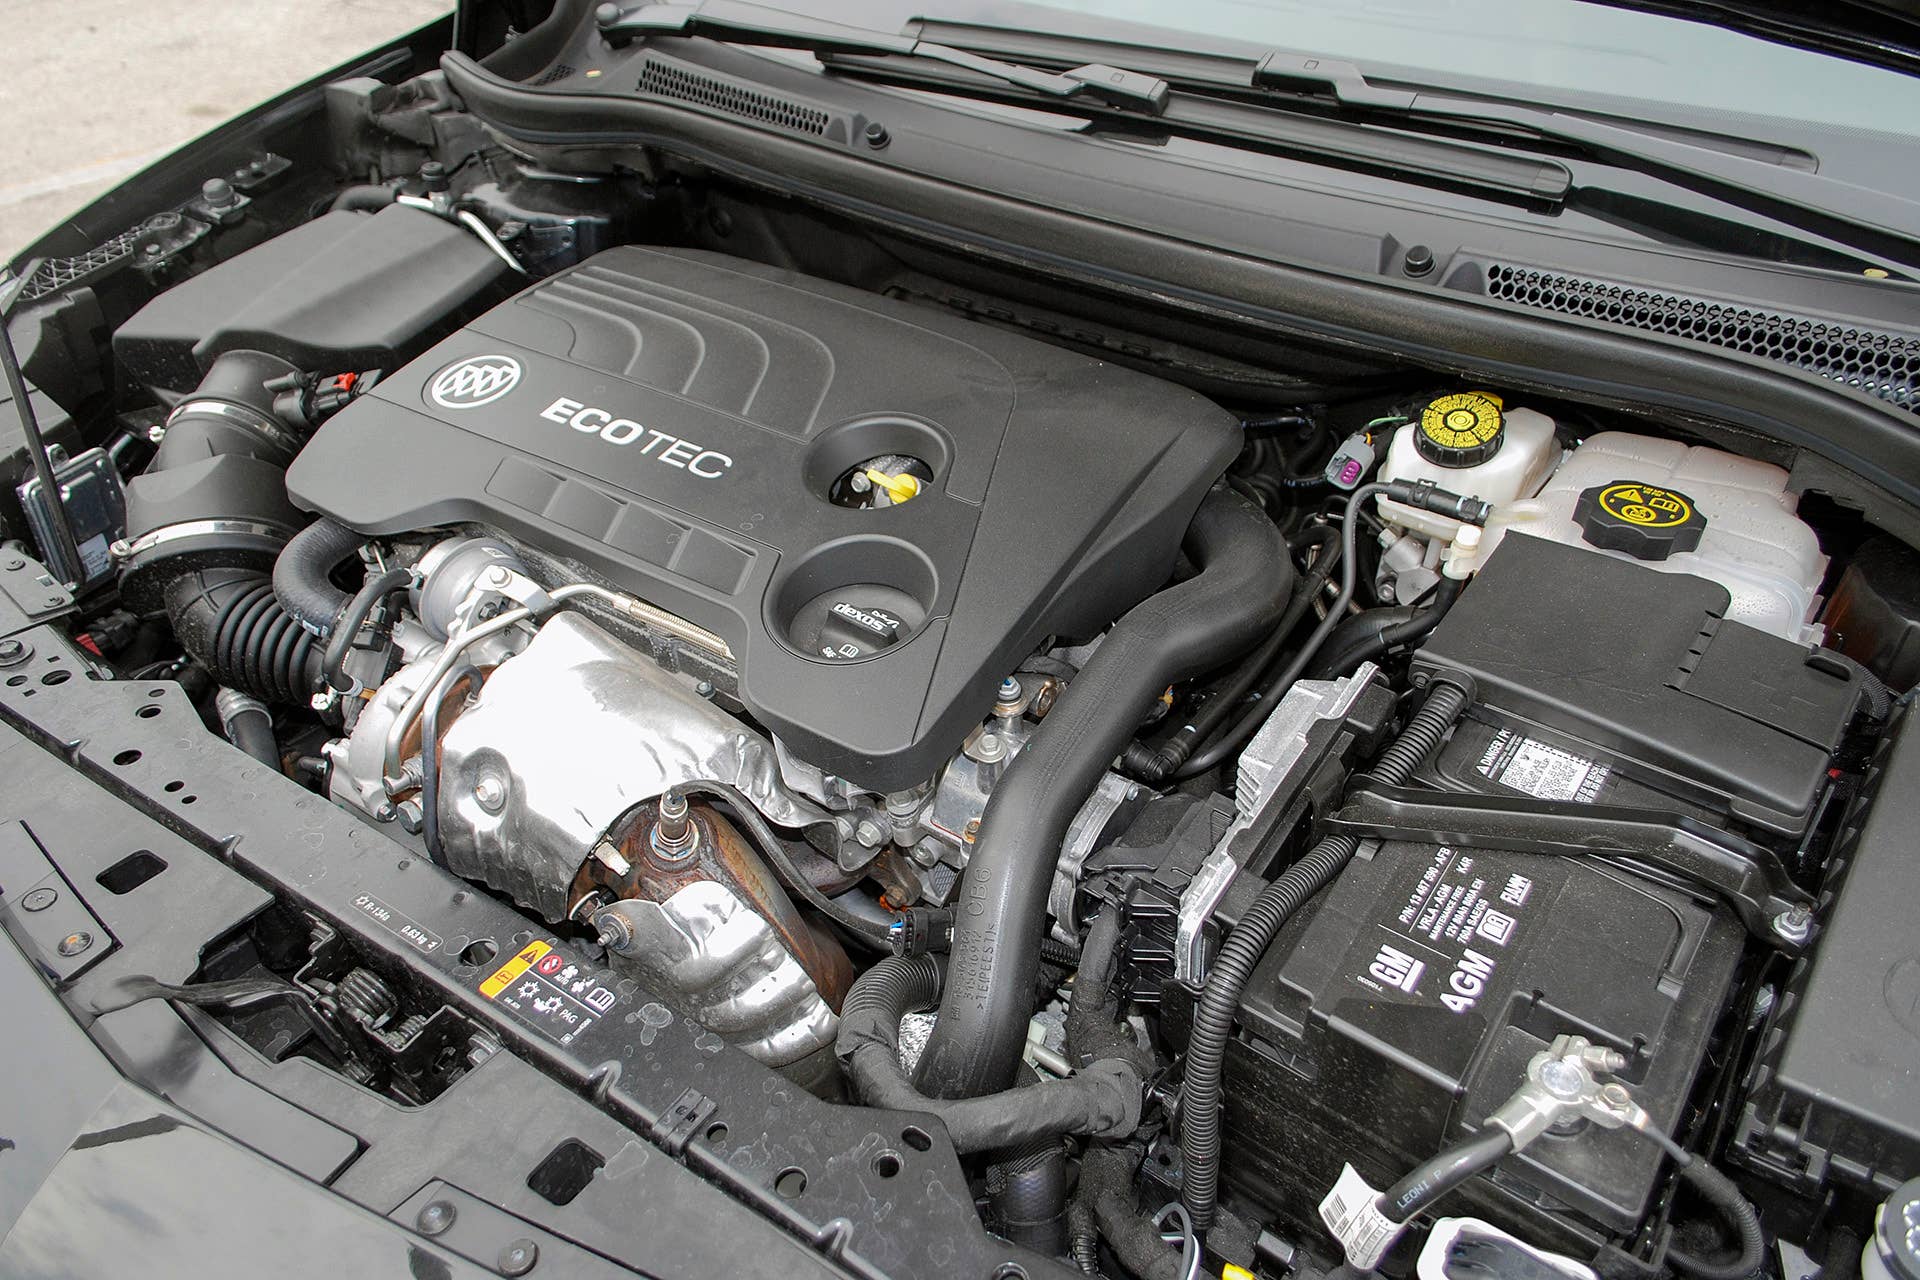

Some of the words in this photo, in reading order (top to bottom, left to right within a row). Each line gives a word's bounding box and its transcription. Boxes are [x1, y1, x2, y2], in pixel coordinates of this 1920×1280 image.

[540, 398, 732, 477] ECOTEC
[834, 604, 887, 630] dexos
[1481, 740, 1503, 766] DANGER
[1434, 847, 1451, 865] AFB
[365, 902, 390, 921] R-134a
[1417, 907, 1439, 932] VRLA
[1434, 884, 1452, 903] AGM
[1369, 944, 1415, 986] GM
[1440, 949, 1494, 1011] AGM
[559, 1009, 578, 1024] PAG
[1397, 1181, 1429, 1208] LEONI
